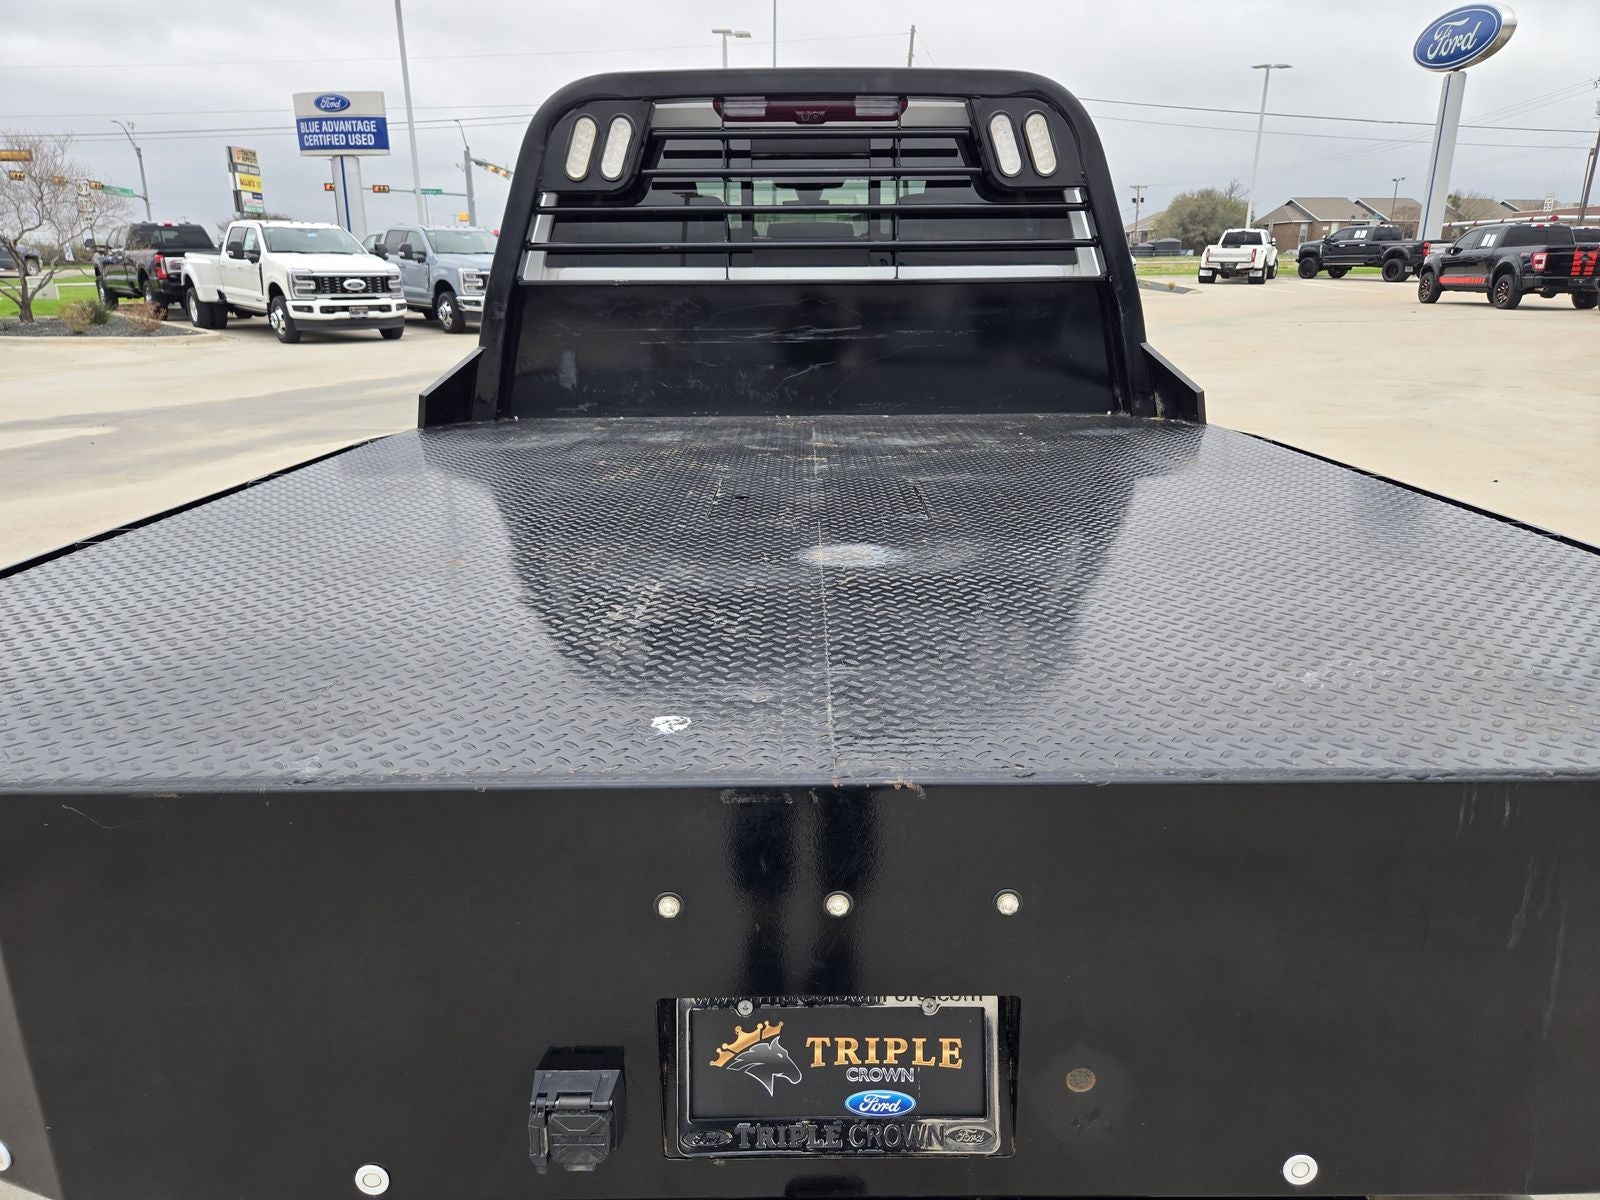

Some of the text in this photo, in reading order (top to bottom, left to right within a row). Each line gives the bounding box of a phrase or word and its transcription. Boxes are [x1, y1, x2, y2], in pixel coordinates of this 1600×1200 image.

[1427, 17, 1482, 60] Ford
[320, 96, 342, 109] Ford
[300, 119, 377, 133] BLUE ADVANTAGE
[304, 133, 375, 147] CERTIFIED USED
[805, 1036, 963, 1070] TRIPLE
[846, 1067, 915, 1083] CROWN
[859, 1093, 902, 1113] Ford
[734, 1123, 843, 1149] TRIPLE
[848, 1123, 945, 1148] CROWN
[954, 1129, 986, 1144] Ford
